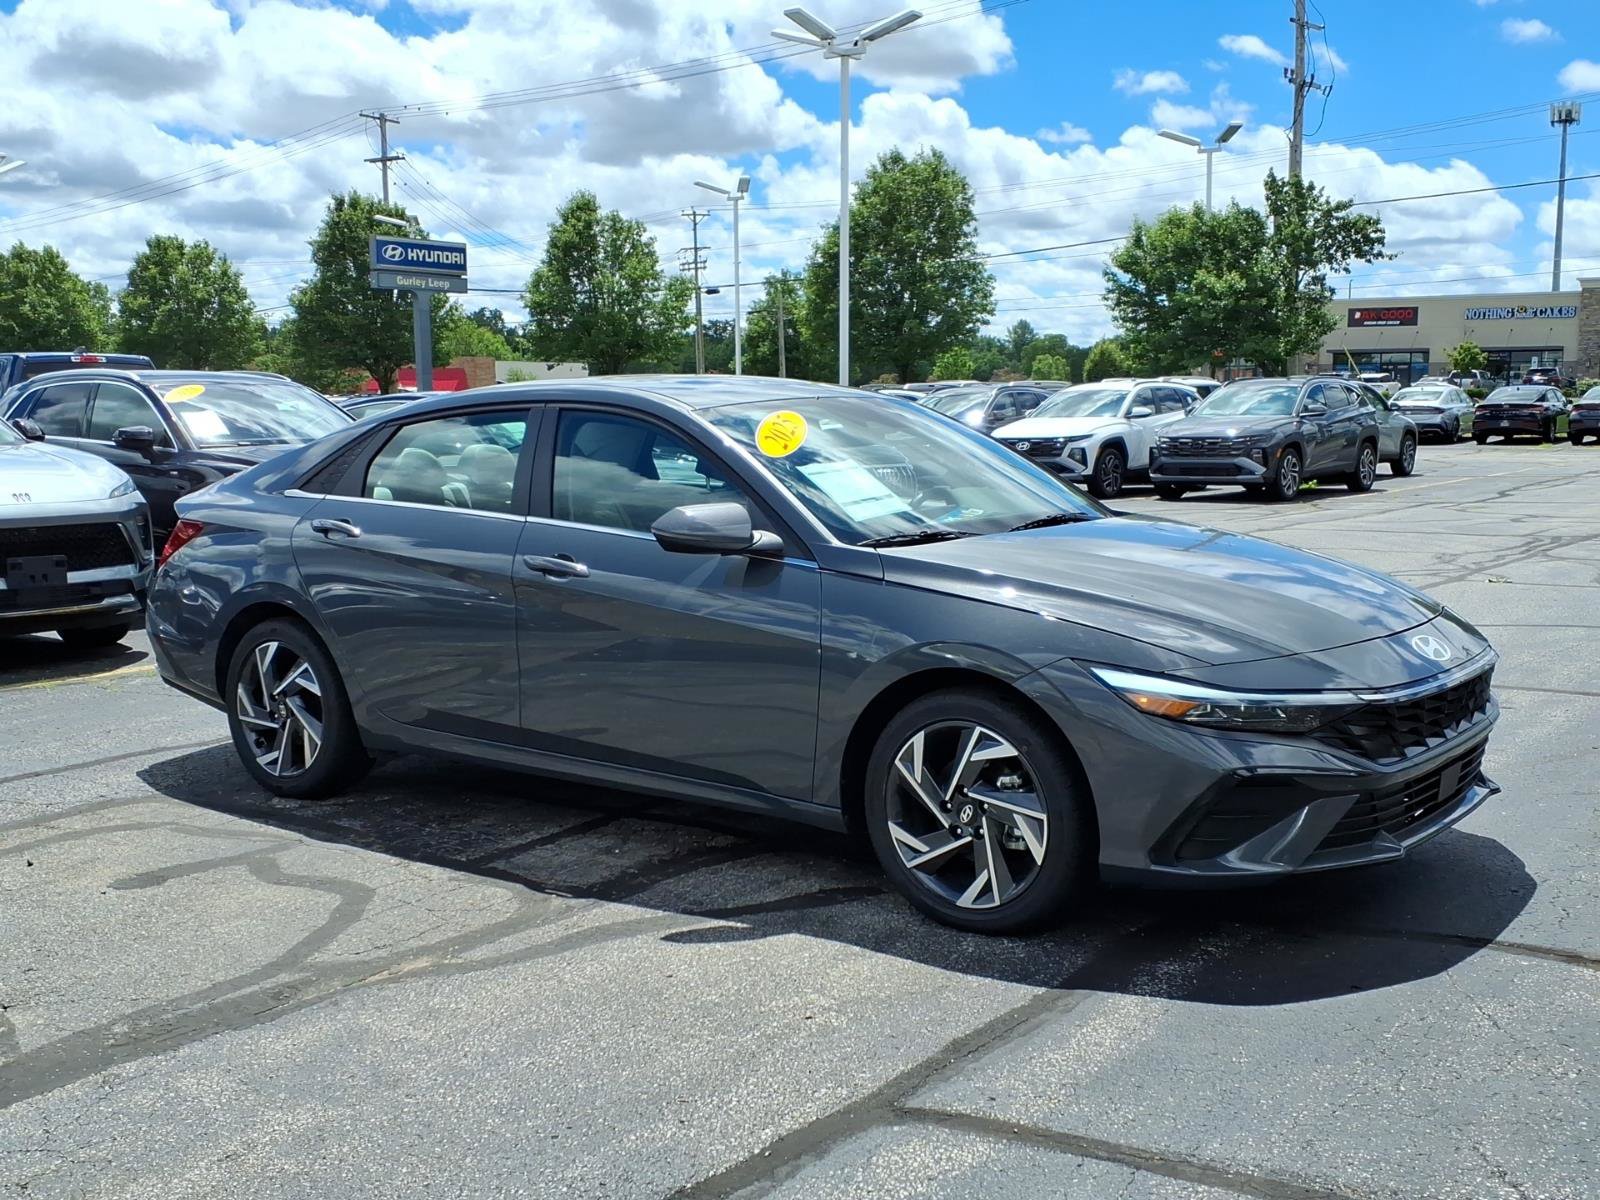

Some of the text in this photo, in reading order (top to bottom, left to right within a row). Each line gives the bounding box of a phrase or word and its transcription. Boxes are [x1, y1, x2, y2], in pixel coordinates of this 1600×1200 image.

[408, 248, 464, 265] HYUNDAI
[396, 275, 450, 290] Gurley Leep
[1464, 307, 1513, 320] NOTHING
[1536, 306, 1576, 319] CAKES
